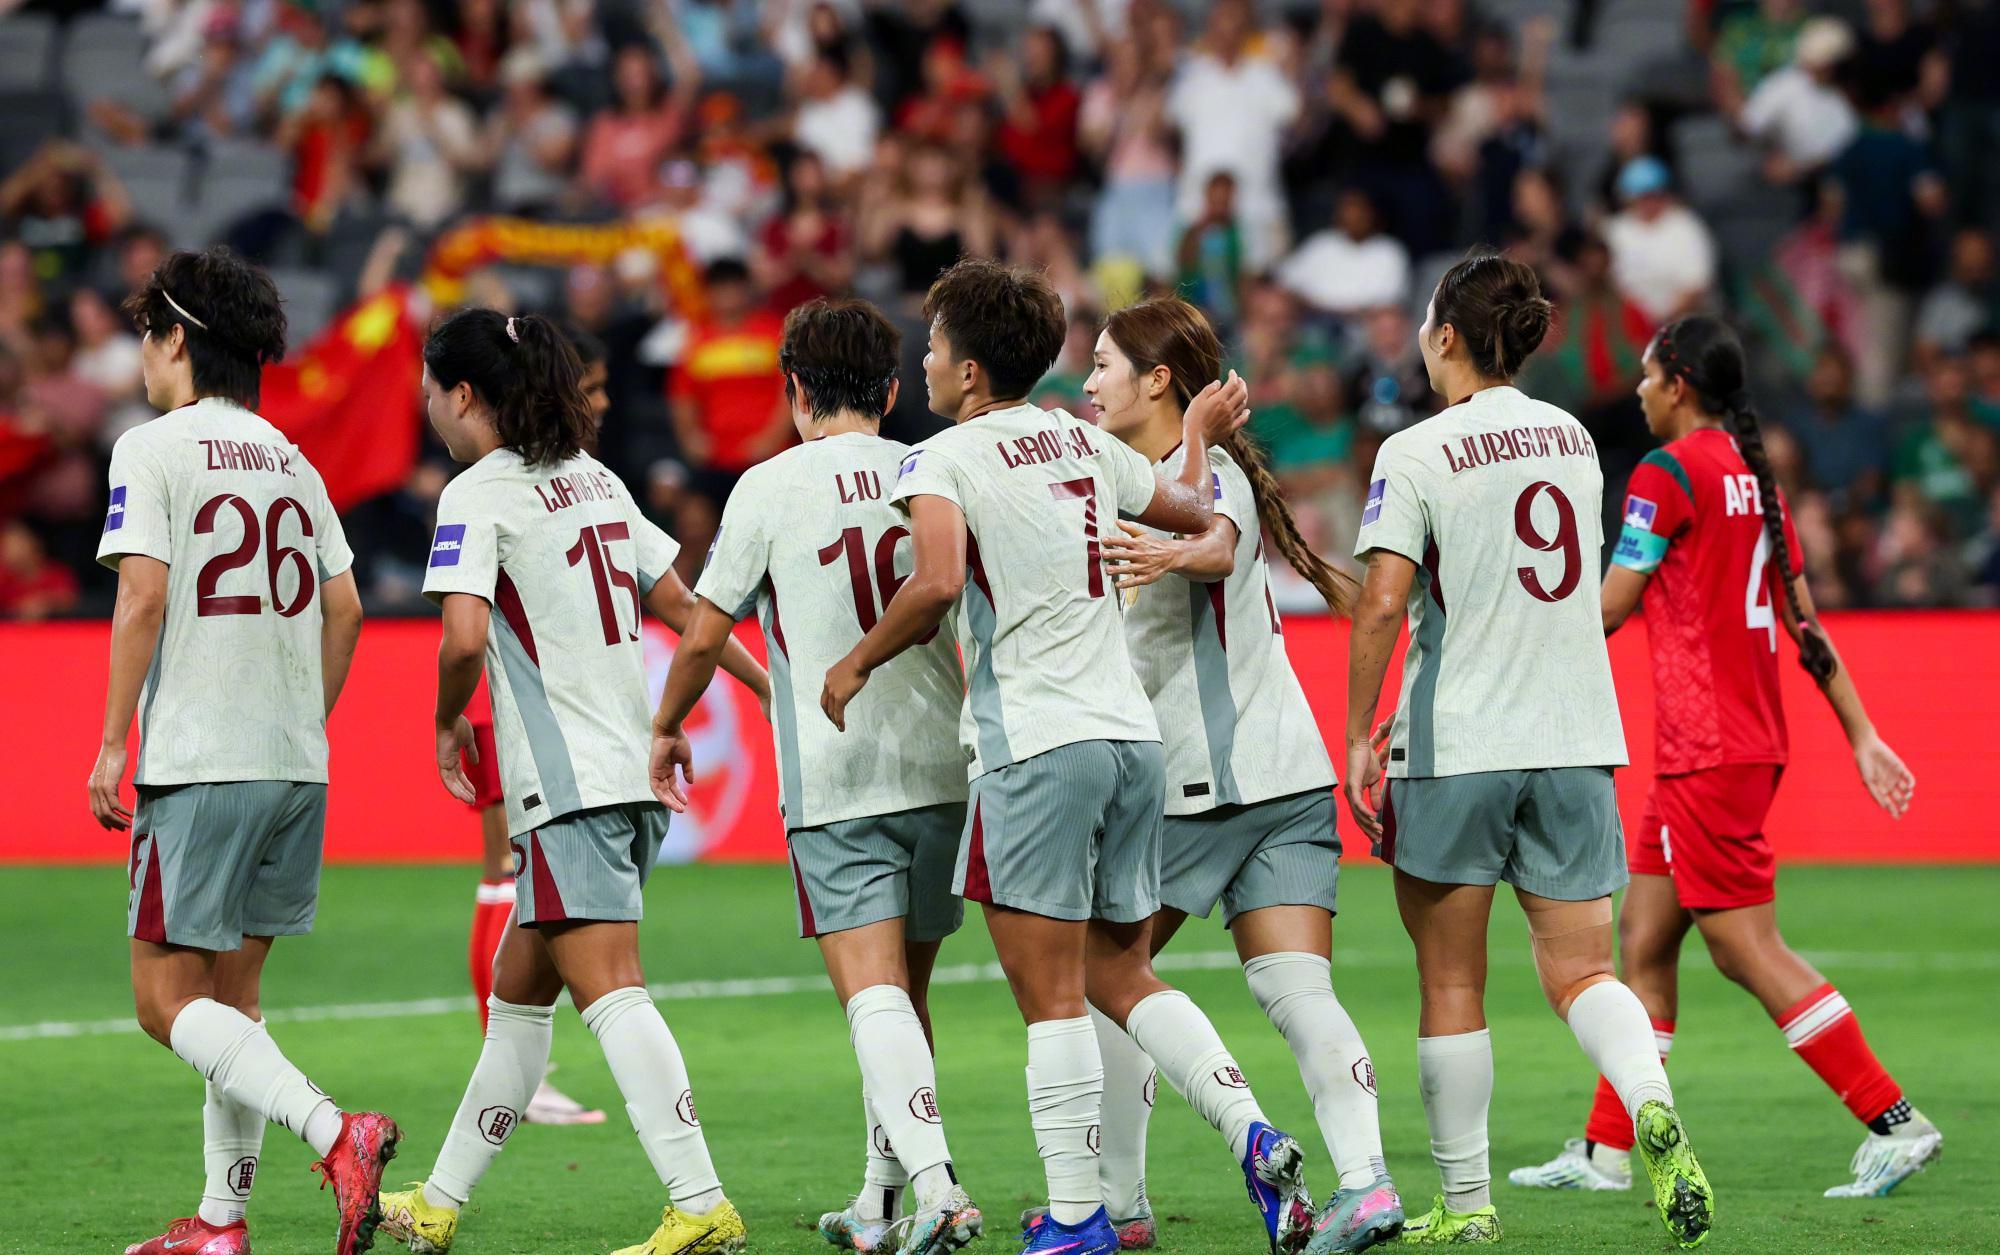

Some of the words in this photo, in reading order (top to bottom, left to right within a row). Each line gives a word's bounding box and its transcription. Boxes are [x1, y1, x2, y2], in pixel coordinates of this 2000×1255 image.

[198, 439, 275, 473] ZHANG
[273, 446, 297, 478] R.
[1442, 424, 1595, 472] WURIGUMULA
[534, 471, 594, 513] WANG
[835, 470, 881, 504] LIU
[193, 493, 315, 618] 26
[1047, 476, 1105, 599] 7
[1514, 480, 1582, 603] 9
[565, 521, 640, 647] 15
[1745, 521, 1777, 653] 4
[487, 1111, 513, 1140] 中国
[238, 1161, 255, 1190] 中国
